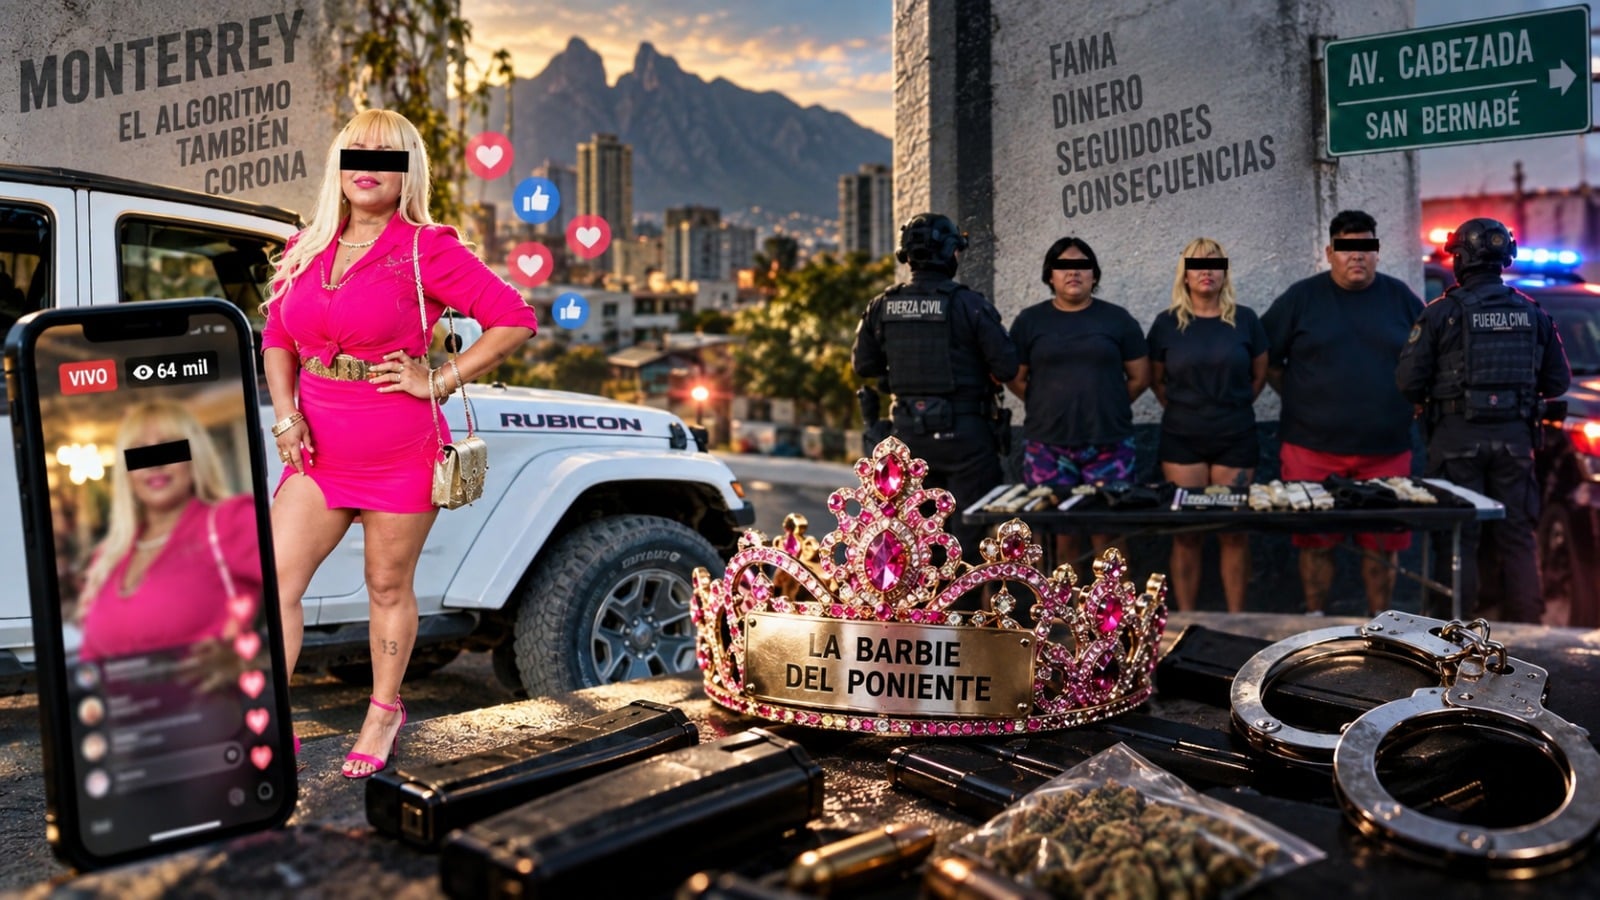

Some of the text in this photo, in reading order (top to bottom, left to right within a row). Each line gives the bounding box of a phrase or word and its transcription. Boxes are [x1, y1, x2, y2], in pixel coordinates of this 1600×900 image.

[20, 9, 304, 113] MONTERREY
[1049, 31, 1117, 80] FAMA
[1348, 28, 1534, 88] AV. CABEZADA
[1052, 74, 1143, 129] DINERO
[1366, 90, 1520, 140] SAN BERNABÉ
[119, 110, 146, 142] EL
[1056, 103, 1212, 176] SEGUIDORES
[205, 150, 307, 196] CORONA
[1061, 134, 1276, 218] CONSECUENCIAS
[886, 300, 943, 315] FUERZA CIVIL
[1472, 312, 1531, 328] FUERZA CIVIL
[68, 368, 108, 387] VIVO
[156, 359, 208, 379] 64 mil
[500, 413, 642, 431] RUBICON
[381, 639, 398, 656] 13
[808, 633, 961, 667] LA BARBIE
[785, 663, 992, 701] DEL PONIENTE
